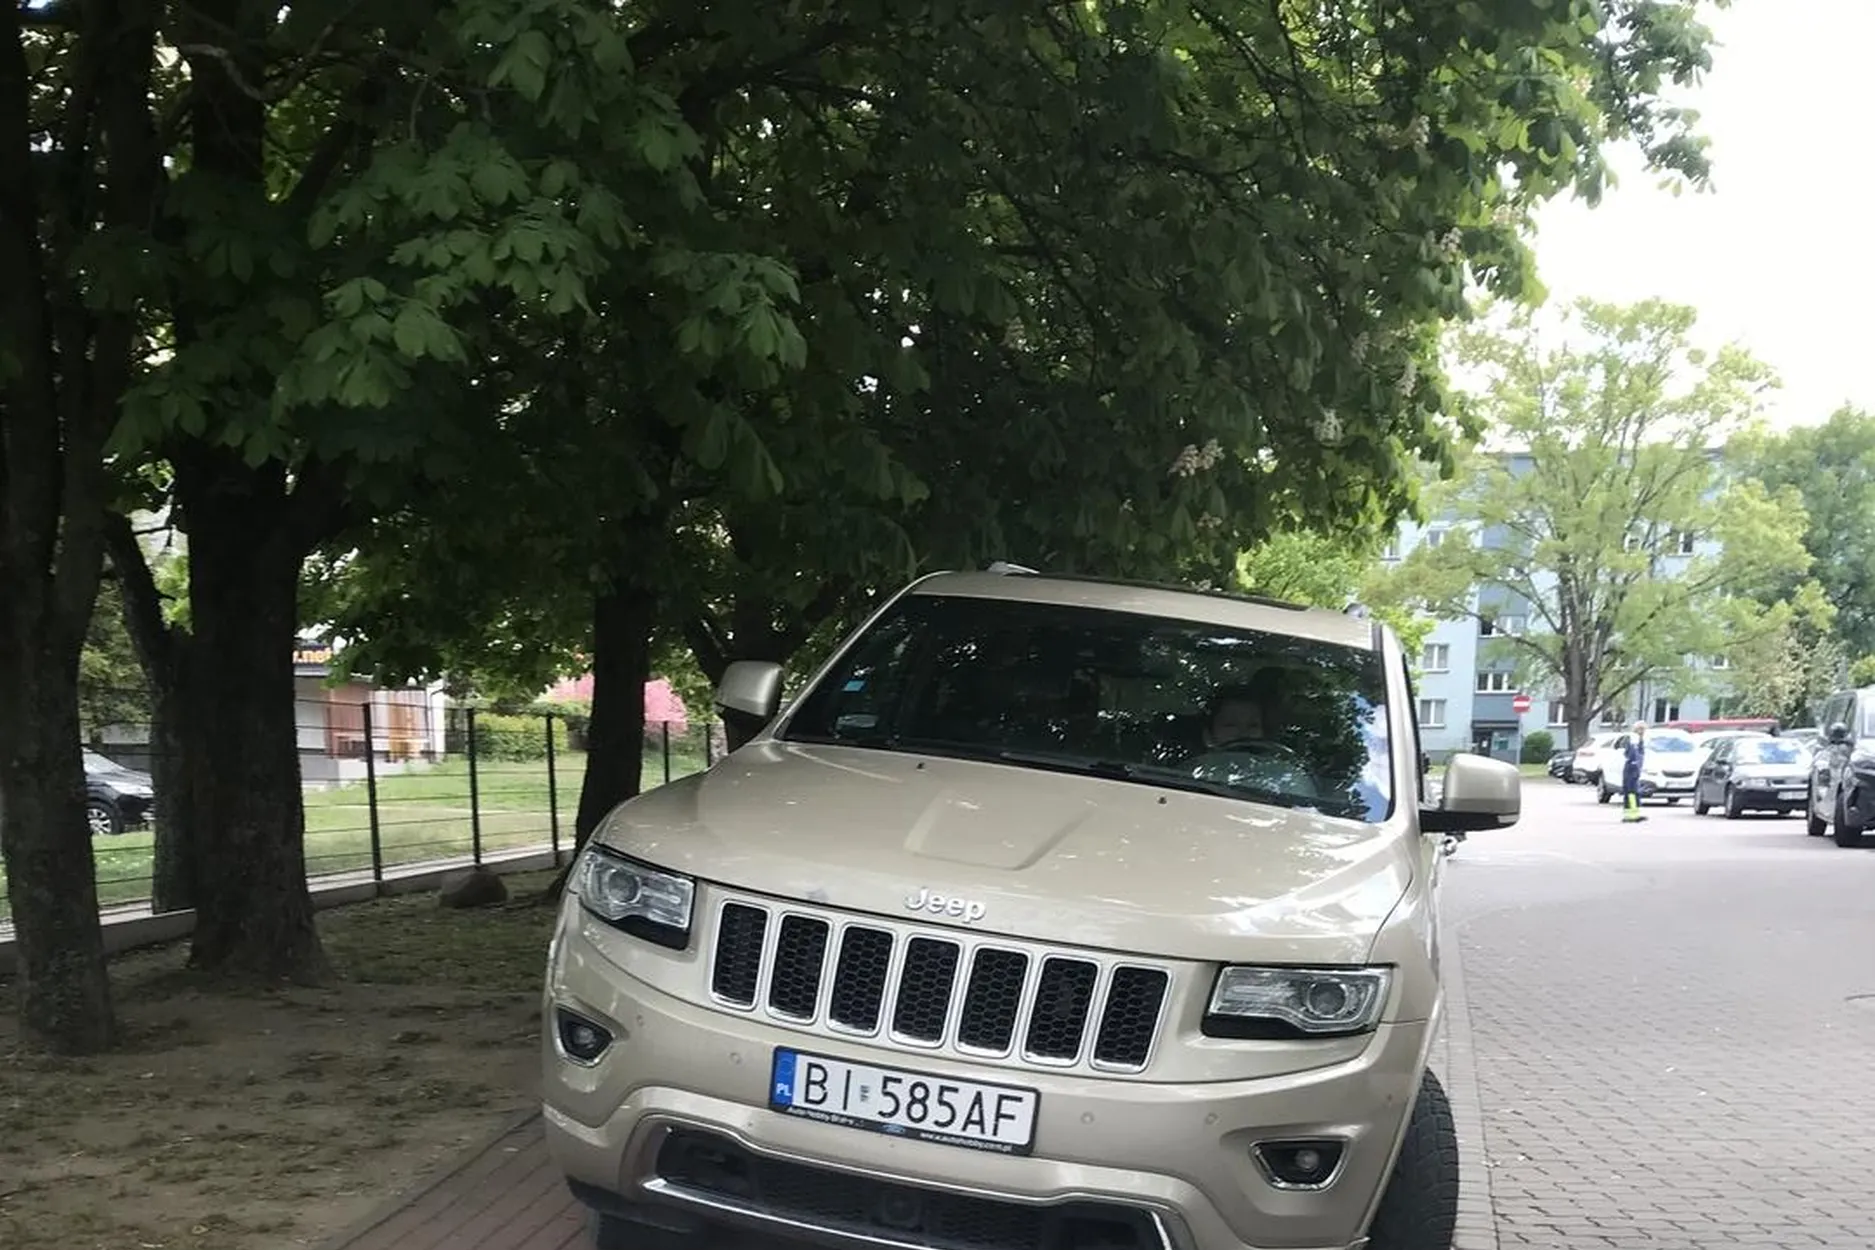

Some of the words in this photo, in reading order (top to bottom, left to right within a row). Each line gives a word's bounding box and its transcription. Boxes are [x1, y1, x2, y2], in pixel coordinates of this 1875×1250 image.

[903, 886, 986, 924] Jeep
[776, 1082, 792, 1097] PL
[804, 1062, 852, 1111] BI
[878, 1075, 1024, 1137] 585AF
